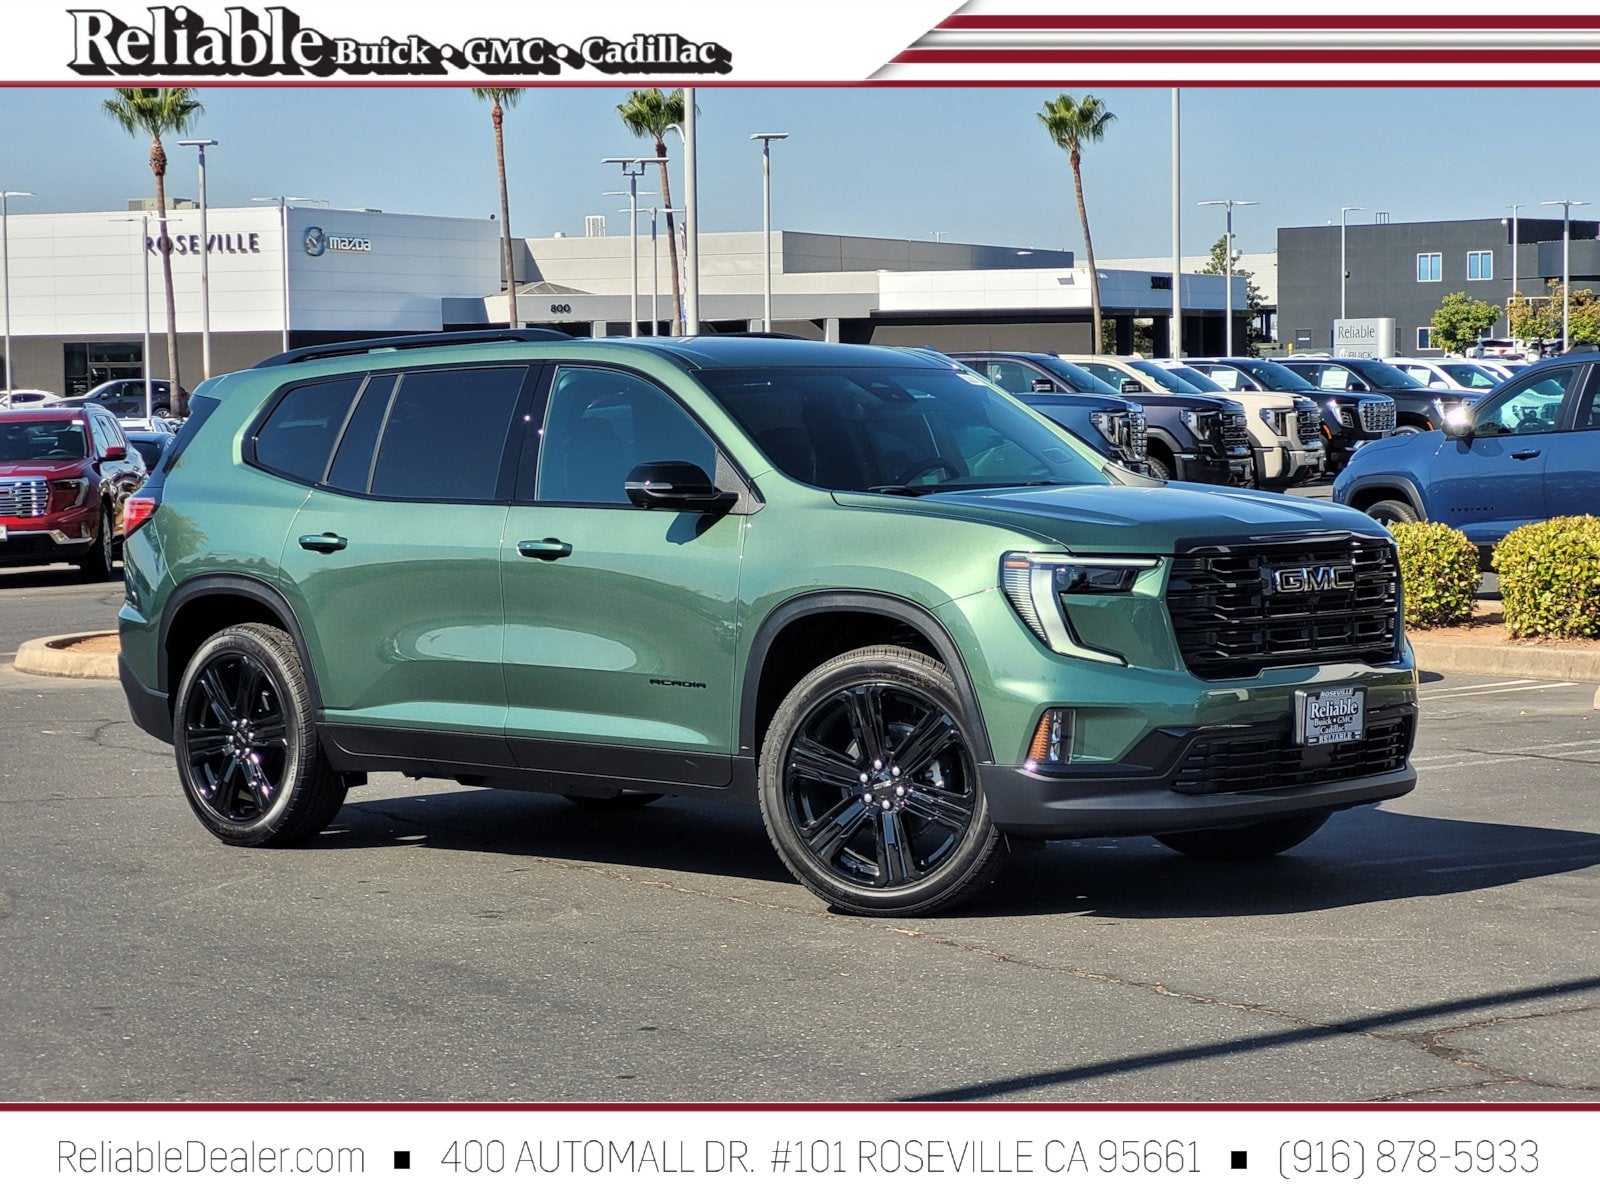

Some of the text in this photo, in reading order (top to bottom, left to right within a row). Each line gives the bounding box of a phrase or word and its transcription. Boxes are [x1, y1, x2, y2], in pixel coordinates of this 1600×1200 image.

[550, 304, 571, 313] 800
[1338, 325, 1375, 339] Reliable
[1275, 566, 1355, 593] GMC
[1320, 687, 1353, 699] ROSEVILLE
[1310, 698, 1359, 719] Reliable
[1314, 714, 1354, 727] Buick GMC
[1319, 724, 1346, 734] Cadillac
[1319, 732, 1352, 744] RELIABLE
